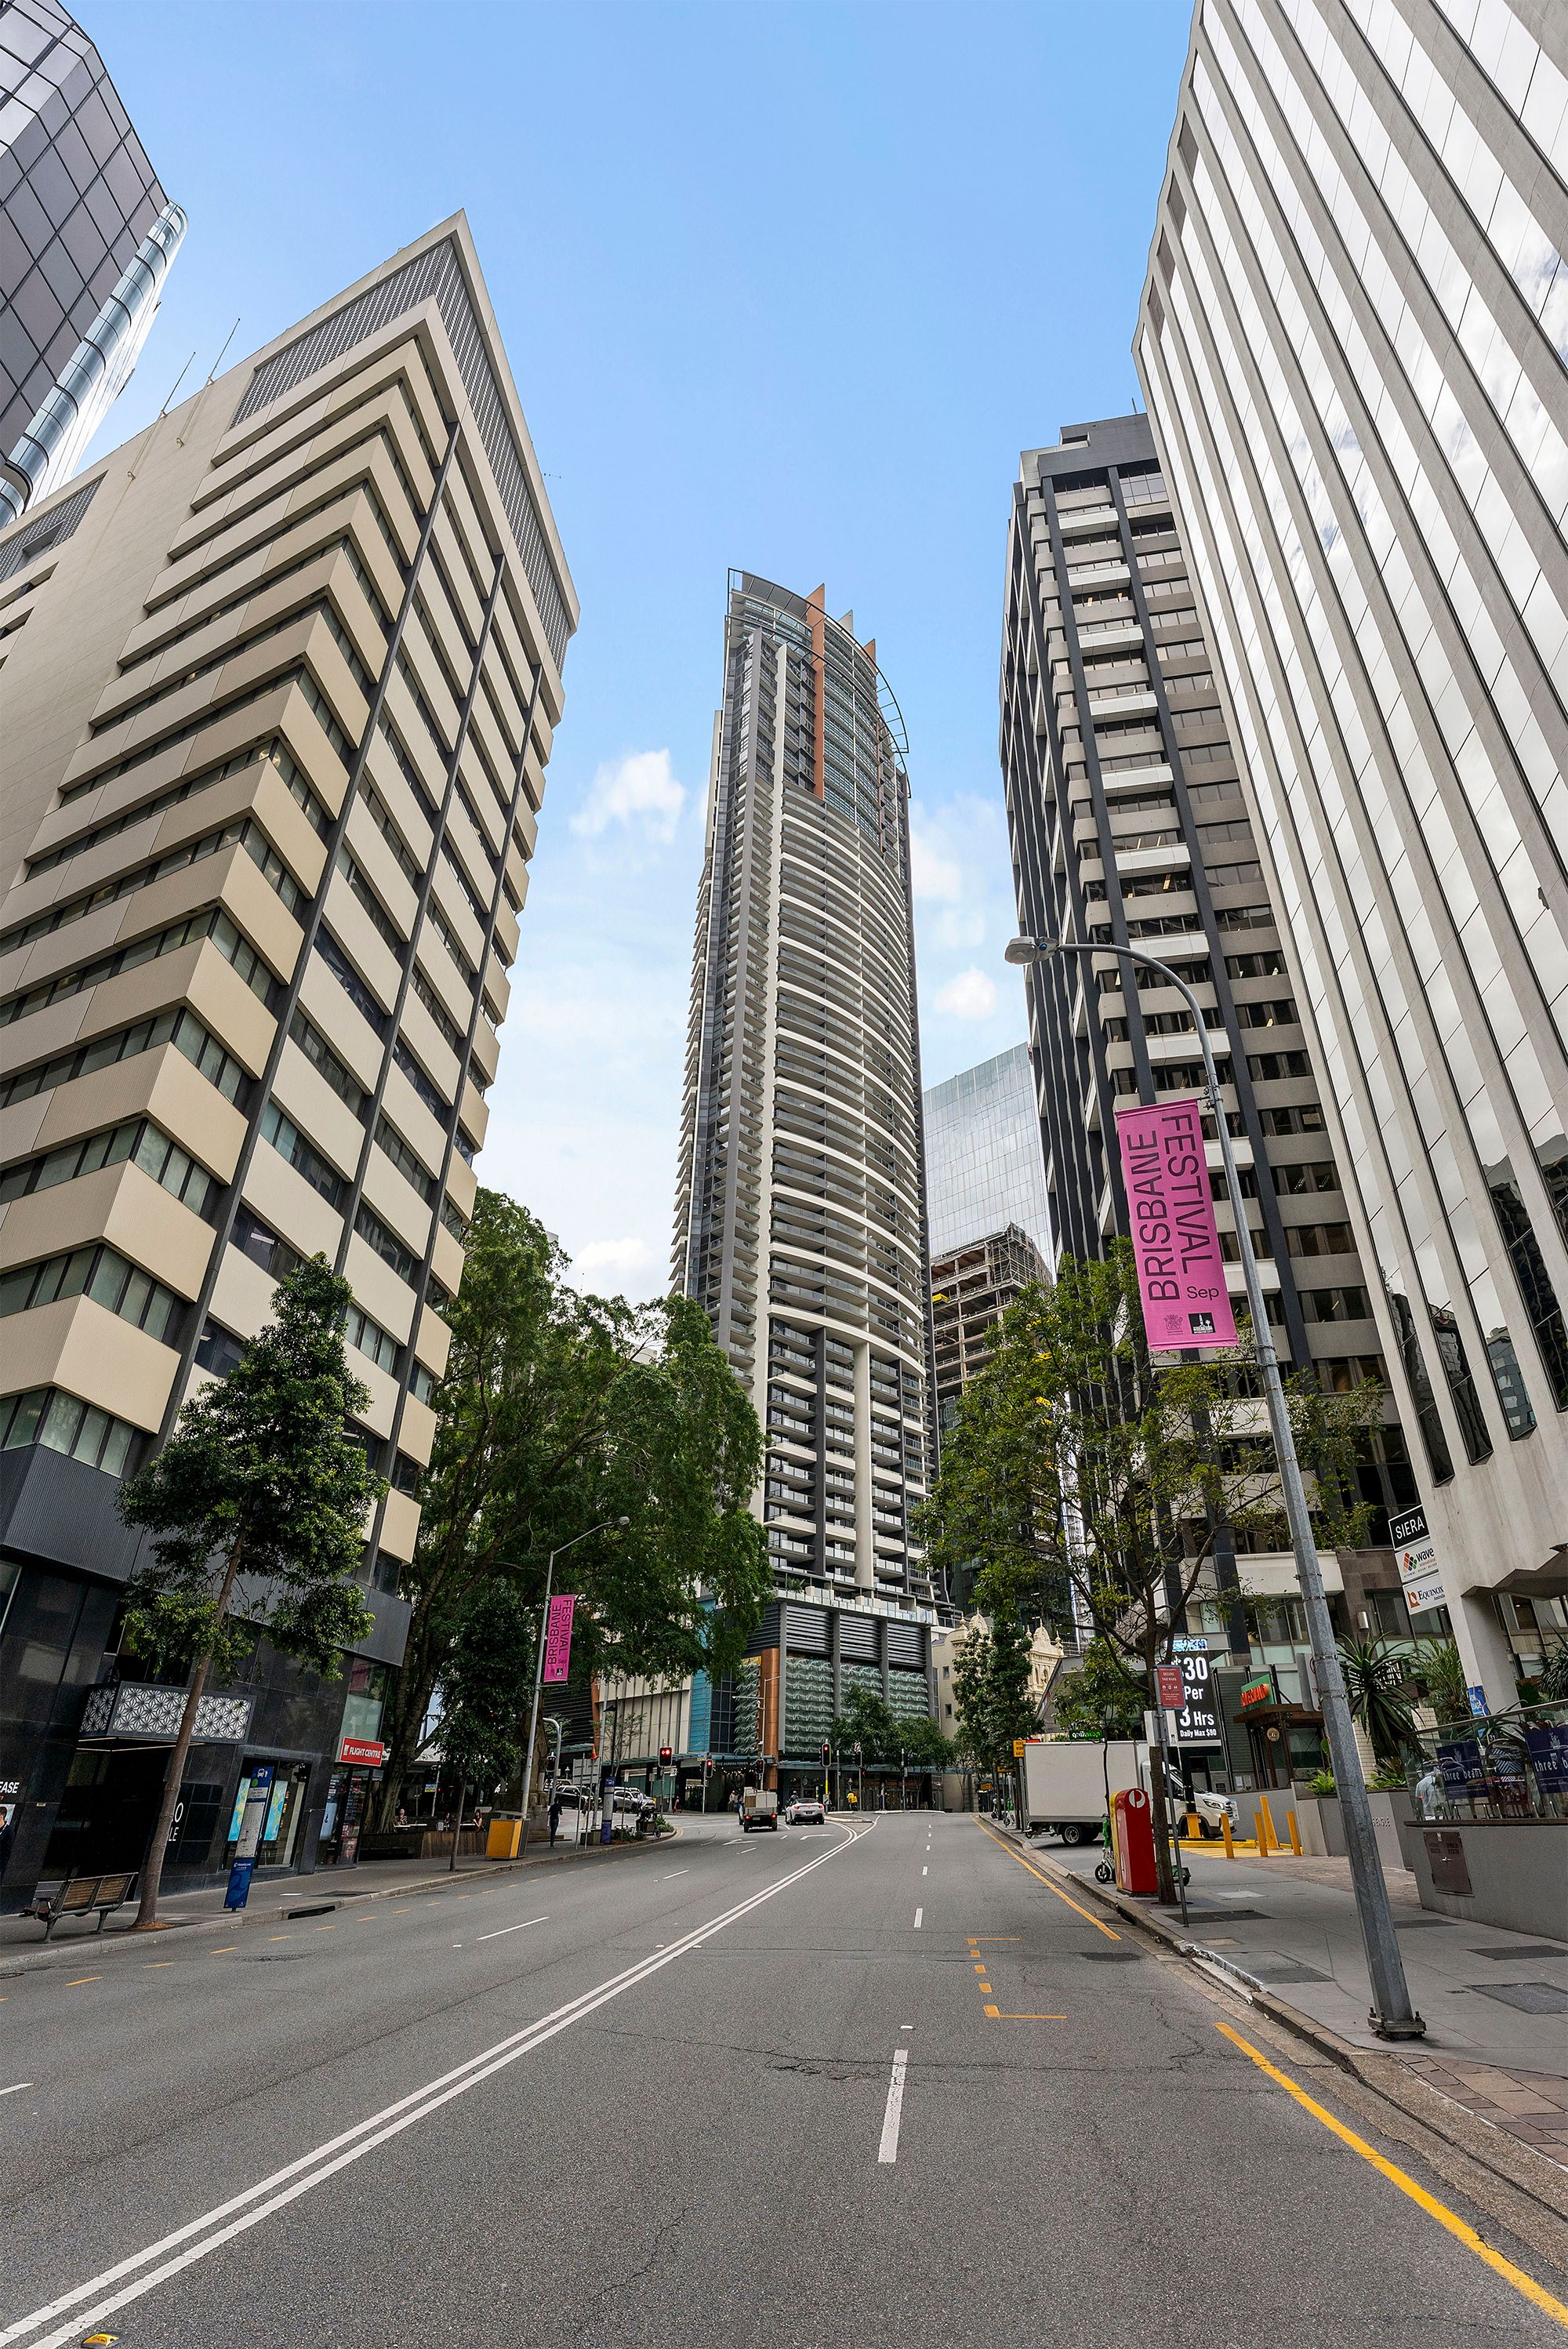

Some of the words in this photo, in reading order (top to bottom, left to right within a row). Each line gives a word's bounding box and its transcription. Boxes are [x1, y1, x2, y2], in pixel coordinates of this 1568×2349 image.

[1161, 1113, 1214, 1274] FESTIVAL
[1127, 1130, 1180, 1302] BRISBANE
[1186, 1285, 1219, 1301] Sep
[1396, 1516, 1425, 1539] SIERA
[1416, 1548, 1434, 1563] wave
[547, 1604, 561, 1665] BRISBANE
[559, 1599, 572, 1655] FESTIVAL
[1184, 1686, 1203, 1700] Per
[1193, 1711, 1214, 1726] Hrs
[1180, 1730, 1193, 1738] Daily
[1206, 1728, 1217, 1737] $90
[349, 1746, 365, 1756] FLIGHT
[365, 1748, 382, 1759] CENTRE
[1443, 1770, 1460, 1781] three
[1463, 1768, 1483, 1779] beans
[1534, 1761, 1558, 1773] three
[0, 1781, 20, 1794] EASE
